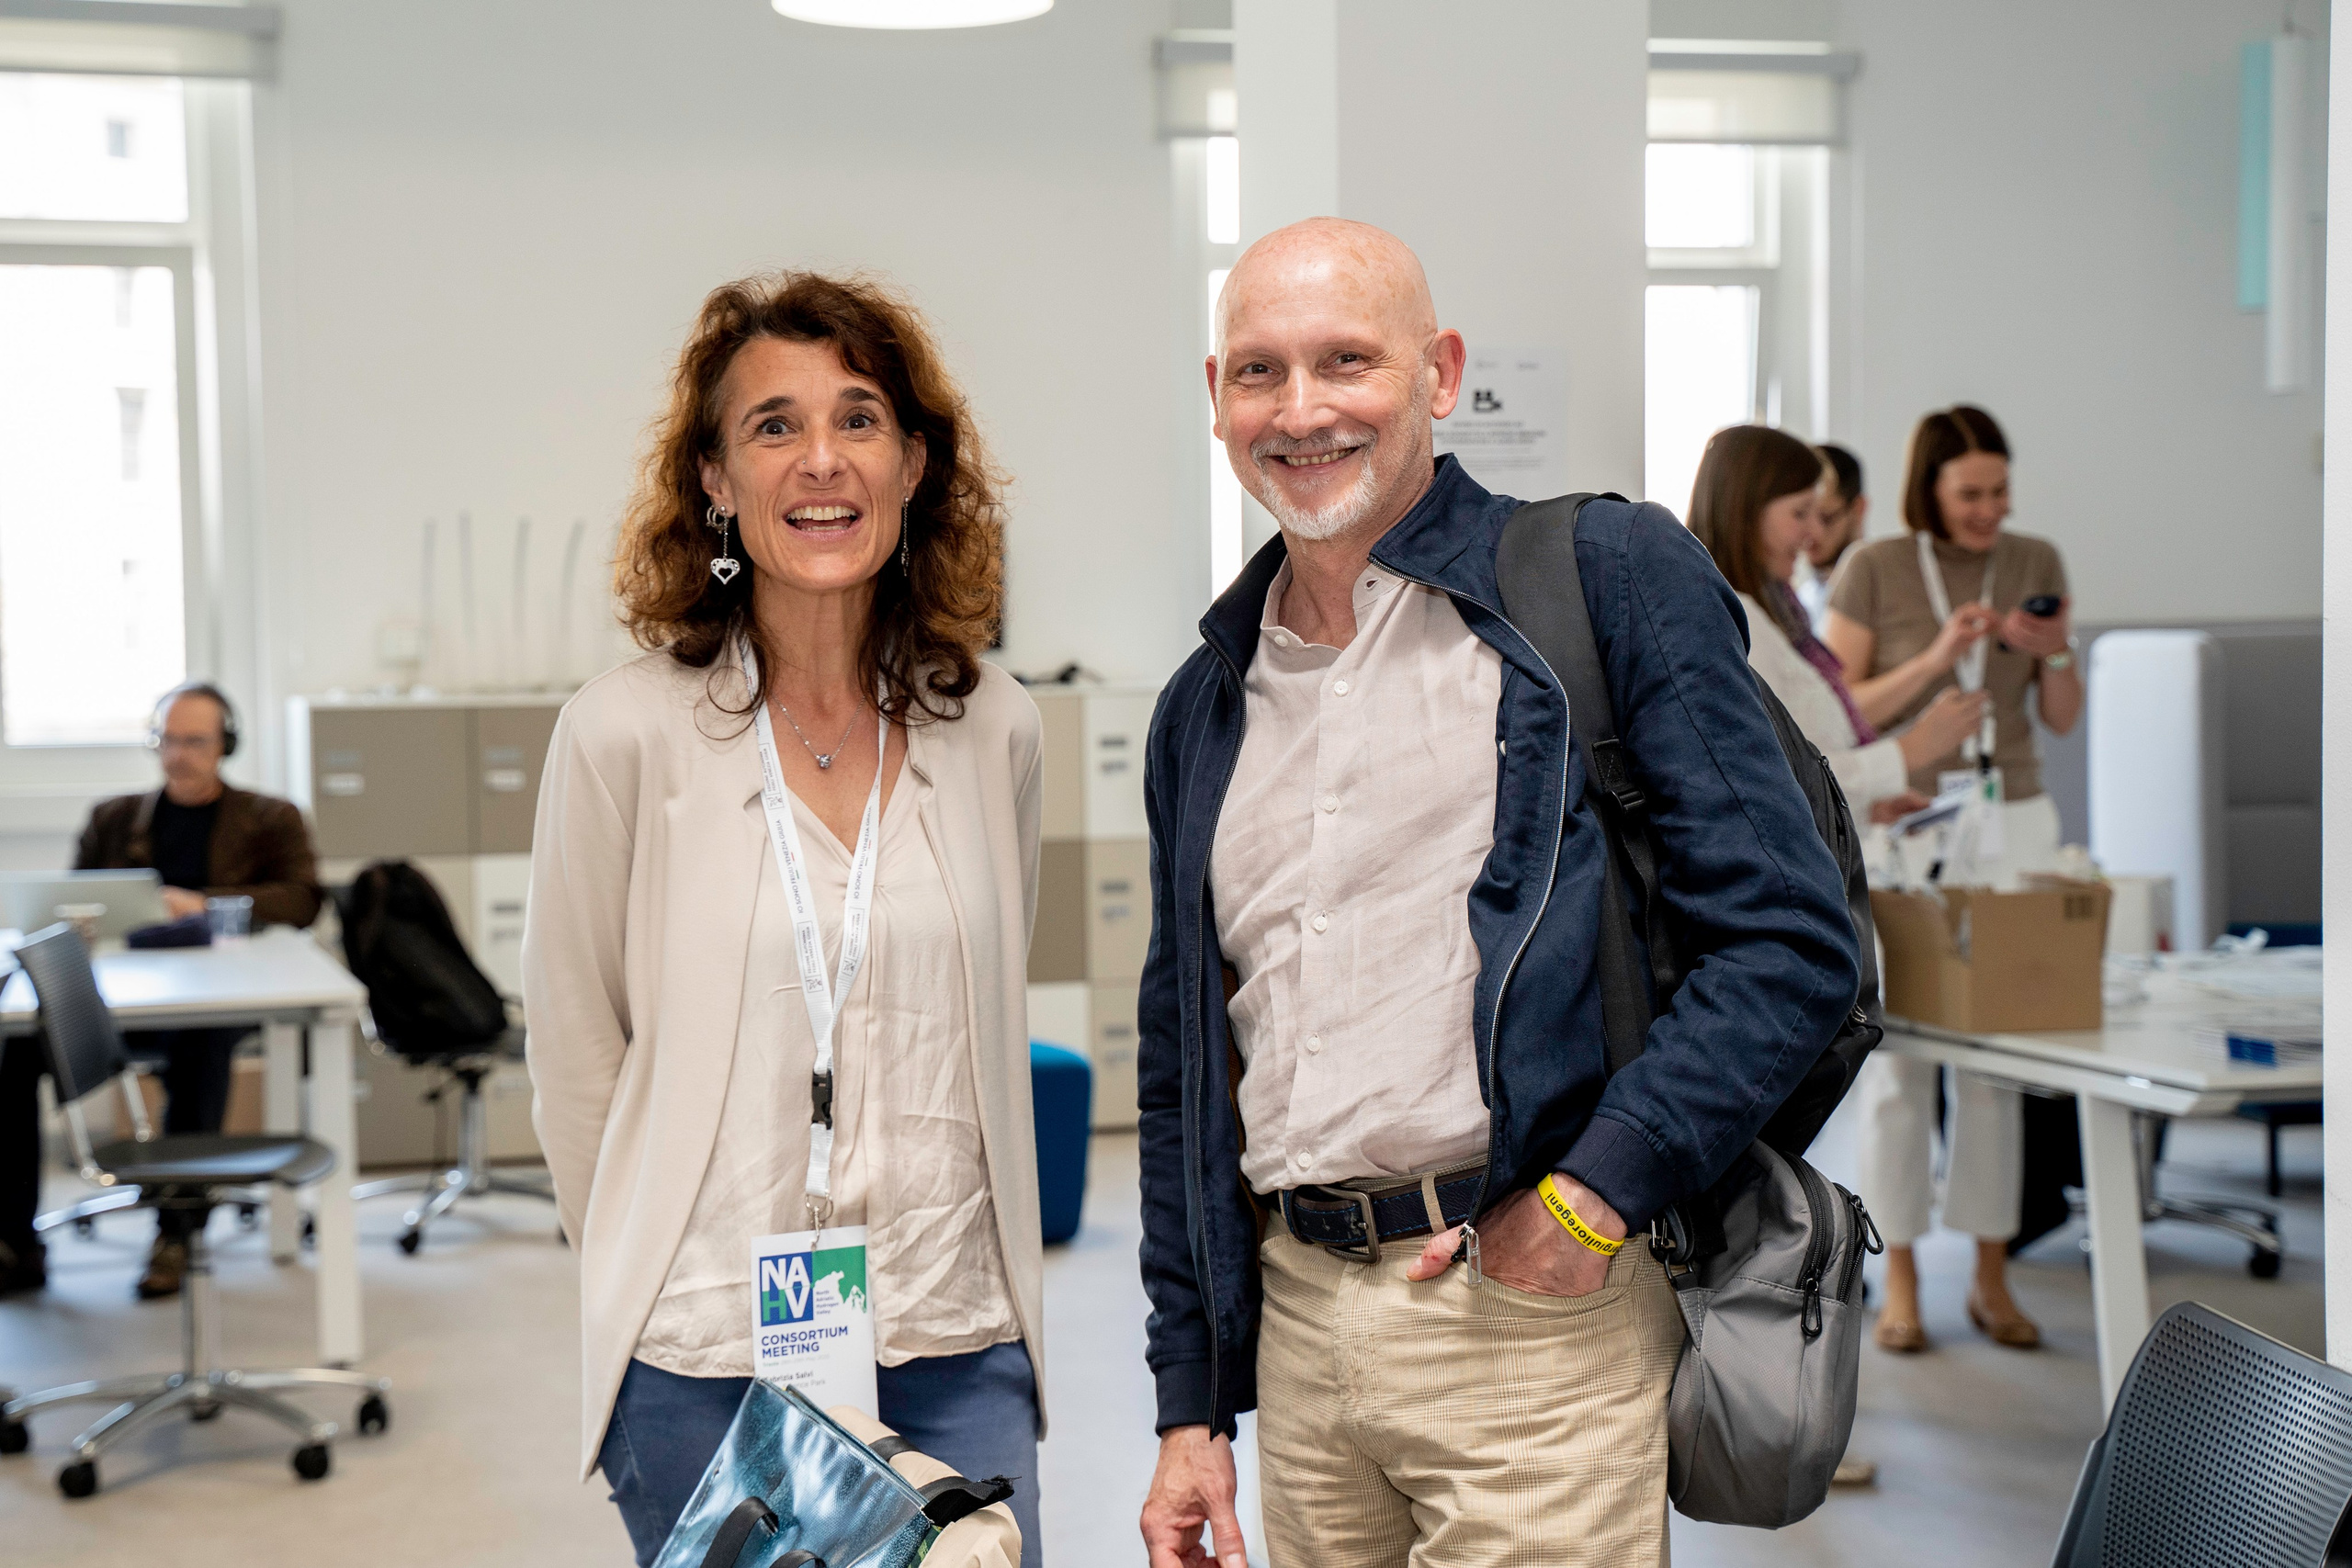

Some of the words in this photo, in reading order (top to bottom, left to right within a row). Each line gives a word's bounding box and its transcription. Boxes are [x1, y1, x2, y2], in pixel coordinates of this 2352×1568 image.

[775, 819, 785, 840] GIULIA
[781, 840, 791, 866] VENEZIA
[792, 885, 801, 905] SONO
[797, 905, 804, 914] IO
[761, 1256, 811, 1292] NA
[762, 1325, 849, 1347] CONSORTIUM
[762, 1341, 820, 1359] MEETING
